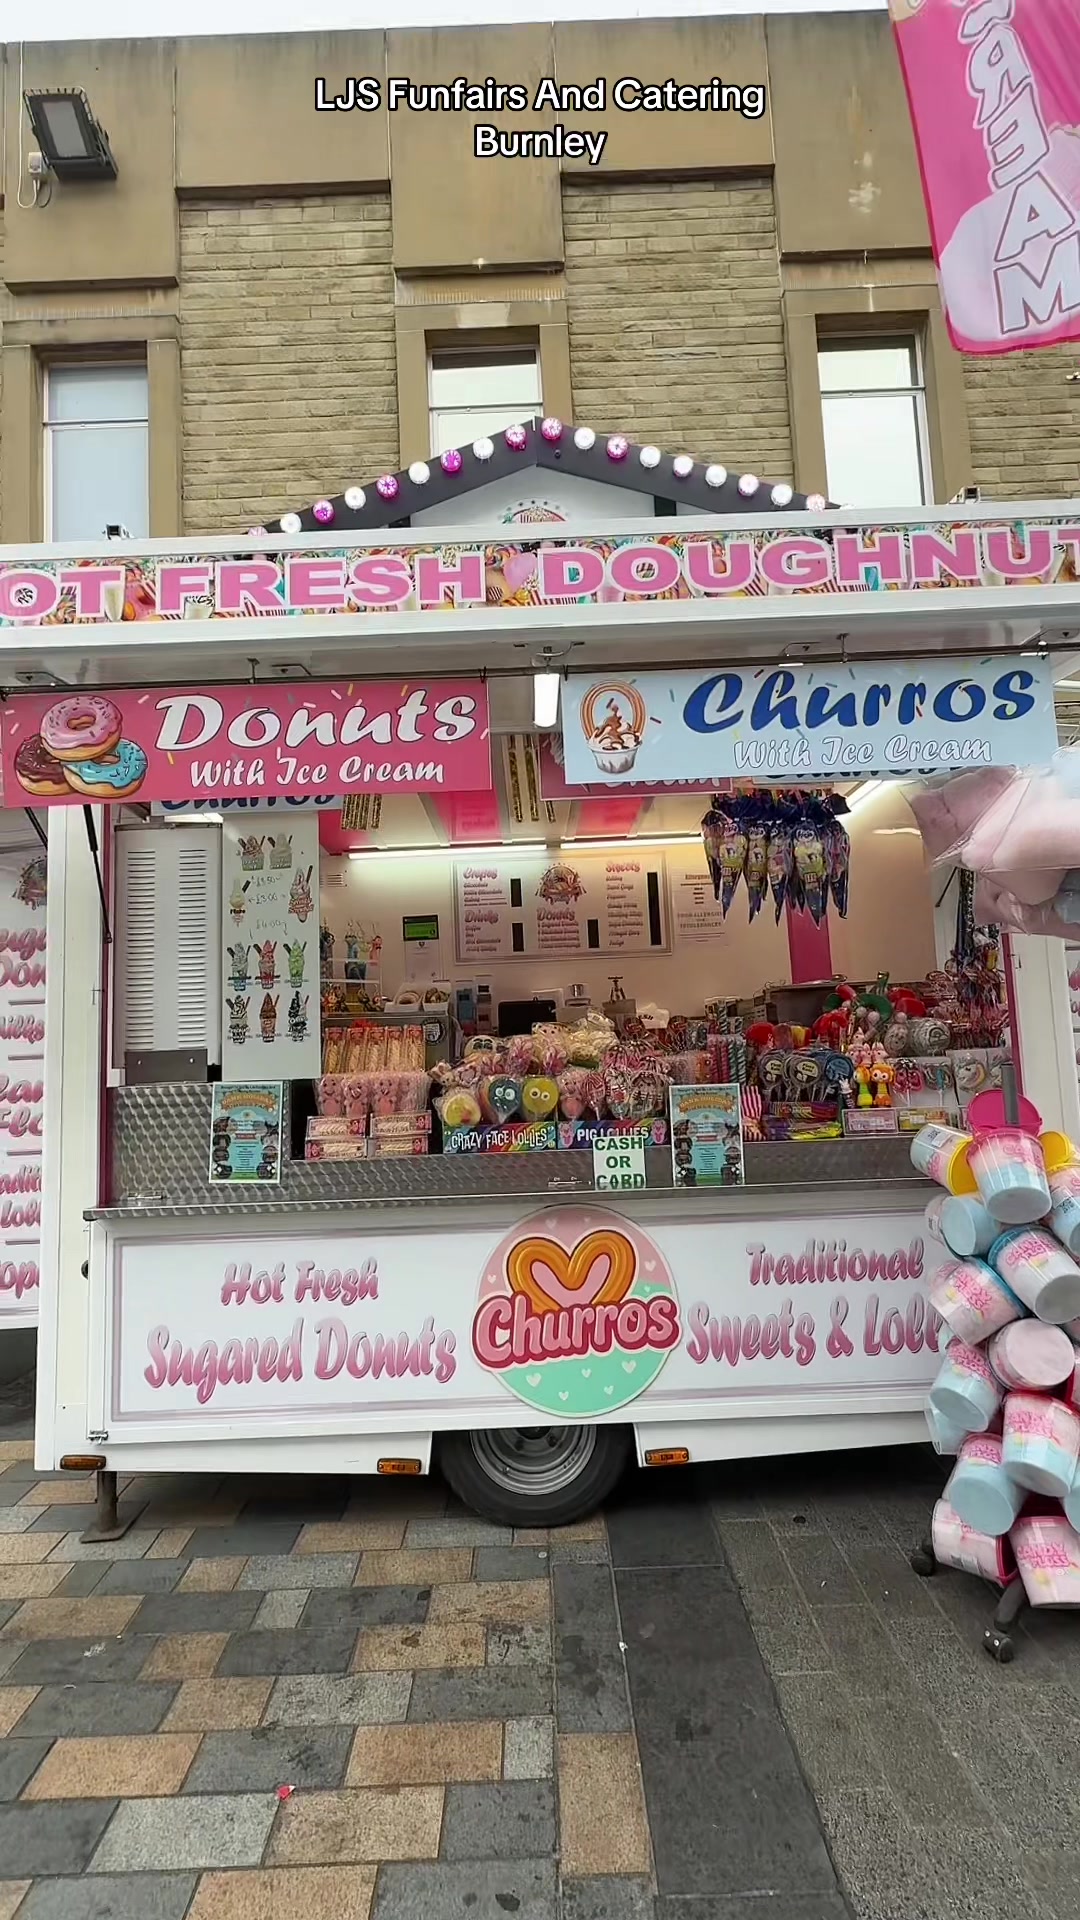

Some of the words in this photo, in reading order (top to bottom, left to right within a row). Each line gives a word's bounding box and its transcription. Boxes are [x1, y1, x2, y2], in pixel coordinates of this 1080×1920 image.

[156, 550, 486, 617] FRESH
[154, 688, 477, 752] Donuts
[683, 669, 1035, 734] Churros
[190, 756, 266, 788] With
[277, 752, 329, 787] Ice
[338, 751, 445, 785] Cream
[733, 737, 811, 770] With
[821, 736, 874, 766] Ice
[884, 732, 993, 764] Cream
[451, 1131, 482, 1150] CRAZY
[486, 1130, 510, 1149] FACE
[511, 1127, 548, 1148] LOLLIES
[576, 1128, 598, 1141] PIG
[594, 1136, 643, 1151] CASH
[605, 1155, 631, 1169] OR
[220, 1260, 287, 1306] Hot
[294, 1256, 379, 1306] Fresh
[746, 1236, 925, 1286] Traditional
[472, 1291, 681, 1369] Churros
[686, 1298, 816, 1367] Sweets
[826, 1295, 854, 1358] &
[143, 1317, 305, 1405] Sugared
[313, 1315, 457, 1384] Donuts
